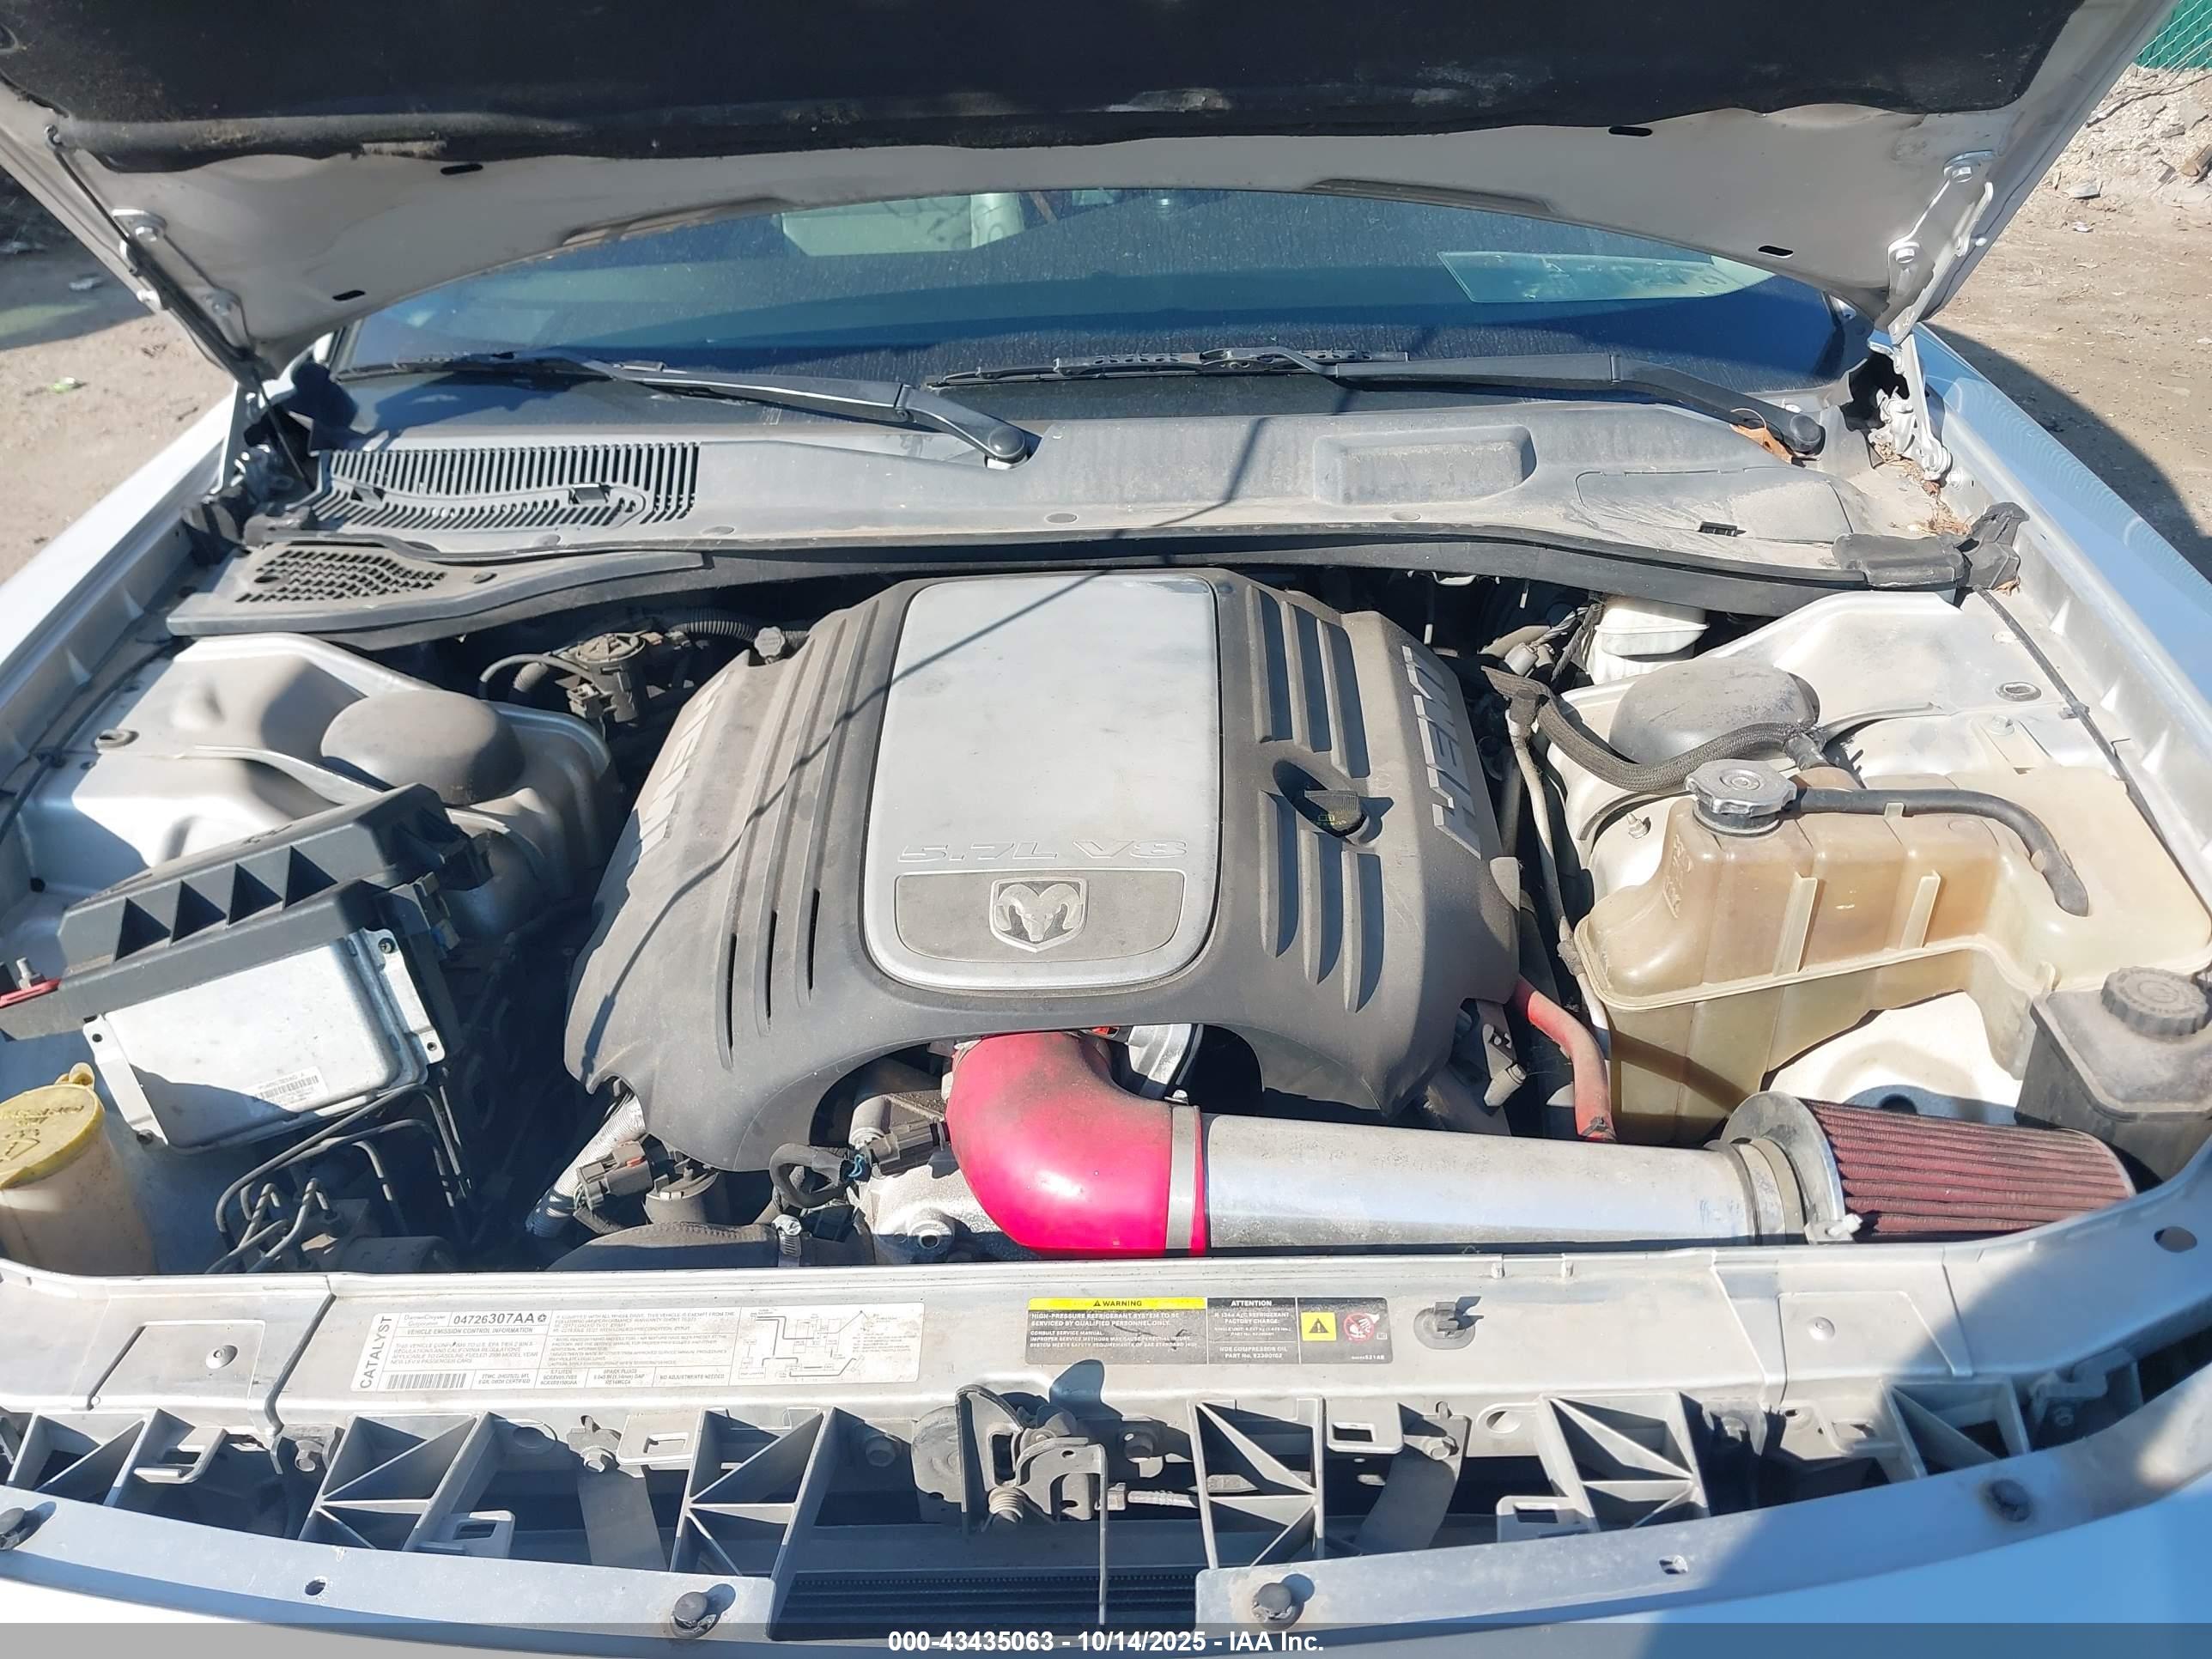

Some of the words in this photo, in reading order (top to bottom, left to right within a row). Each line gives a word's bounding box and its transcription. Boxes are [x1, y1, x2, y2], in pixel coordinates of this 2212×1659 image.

[1401, 645, 1481, 860] HEMI
[897, 841, 1059, 862] 5.7L
[1073, 839, 1188, 859] V8
[453, 1313, 534, 1324] 04726307AA
[361, 1316, 392, 1389] CATALYST
